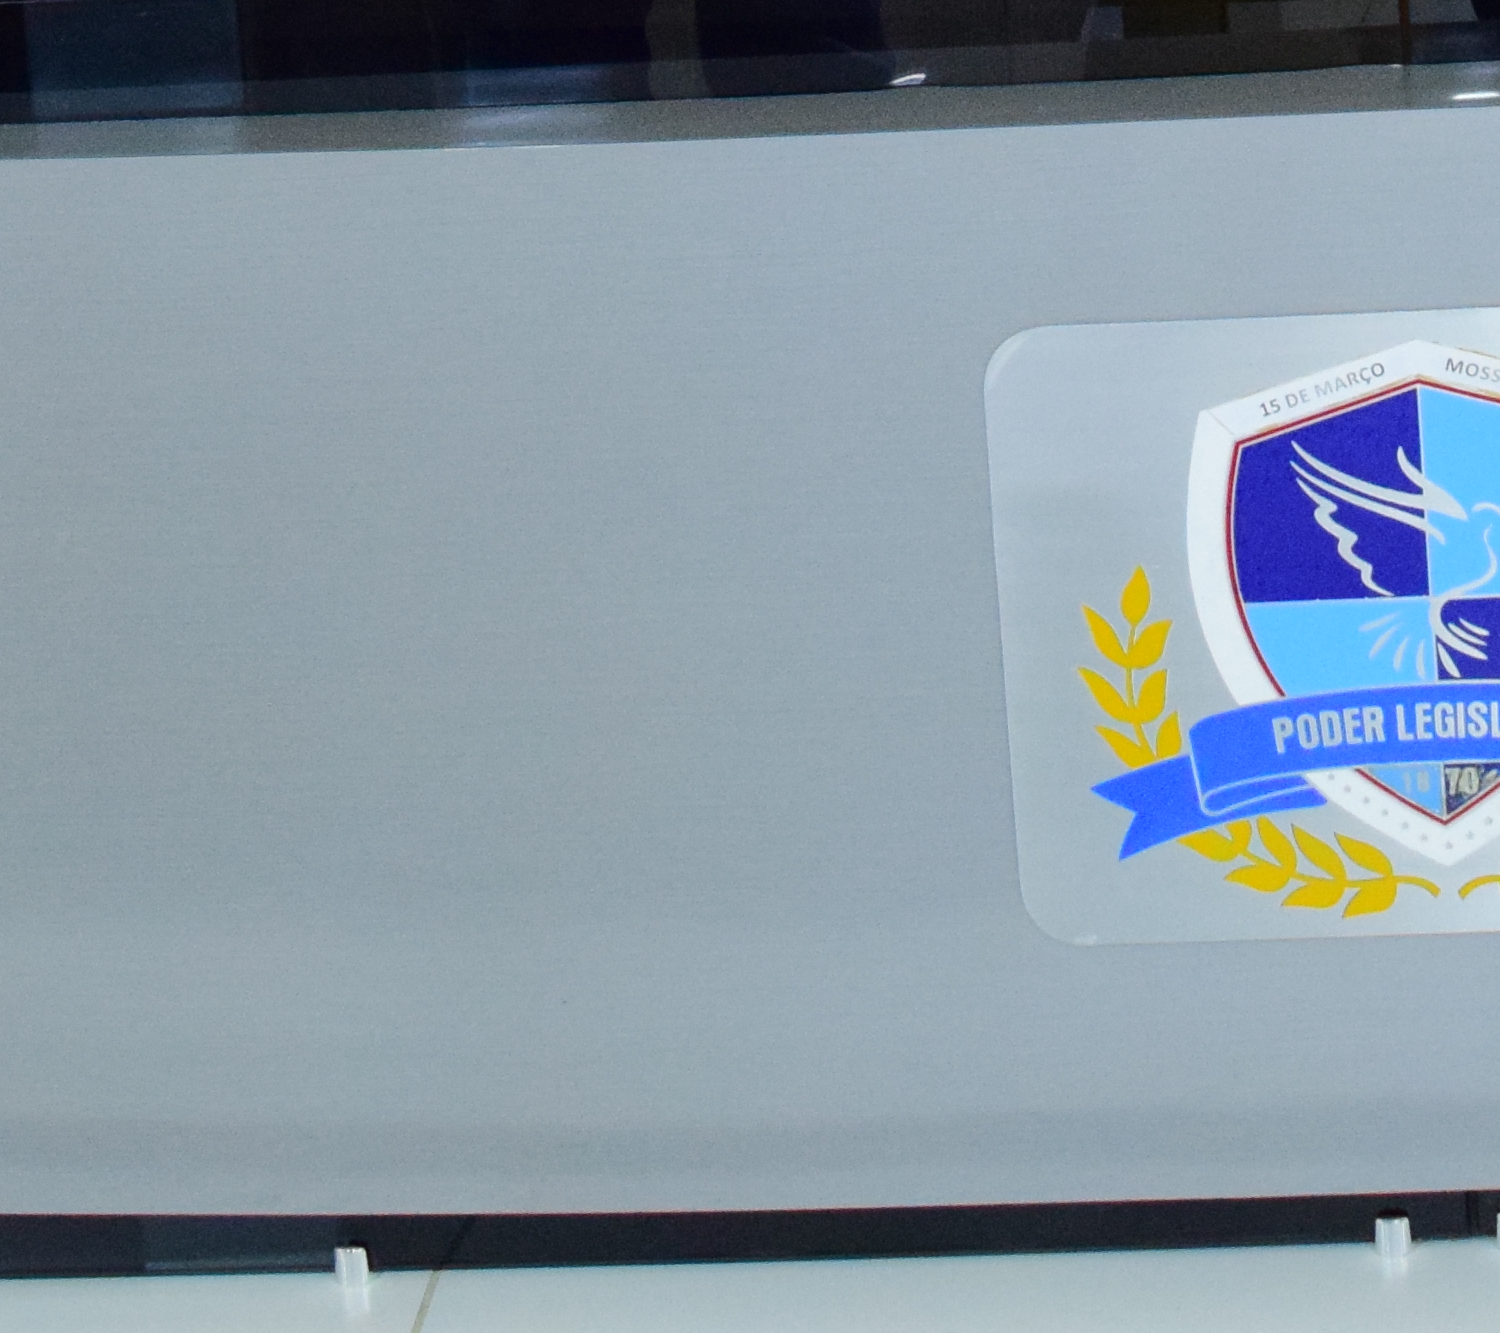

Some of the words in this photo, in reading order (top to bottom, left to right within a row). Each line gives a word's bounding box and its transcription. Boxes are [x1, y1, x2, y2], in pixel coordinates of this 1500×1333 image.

[1259, 399, 1281, 418] 15
[1286, 388, 1311, 408] DE
[1314, 362, 1386, 397] MARÇO
[1271, 706, 1386, 754] PODER
